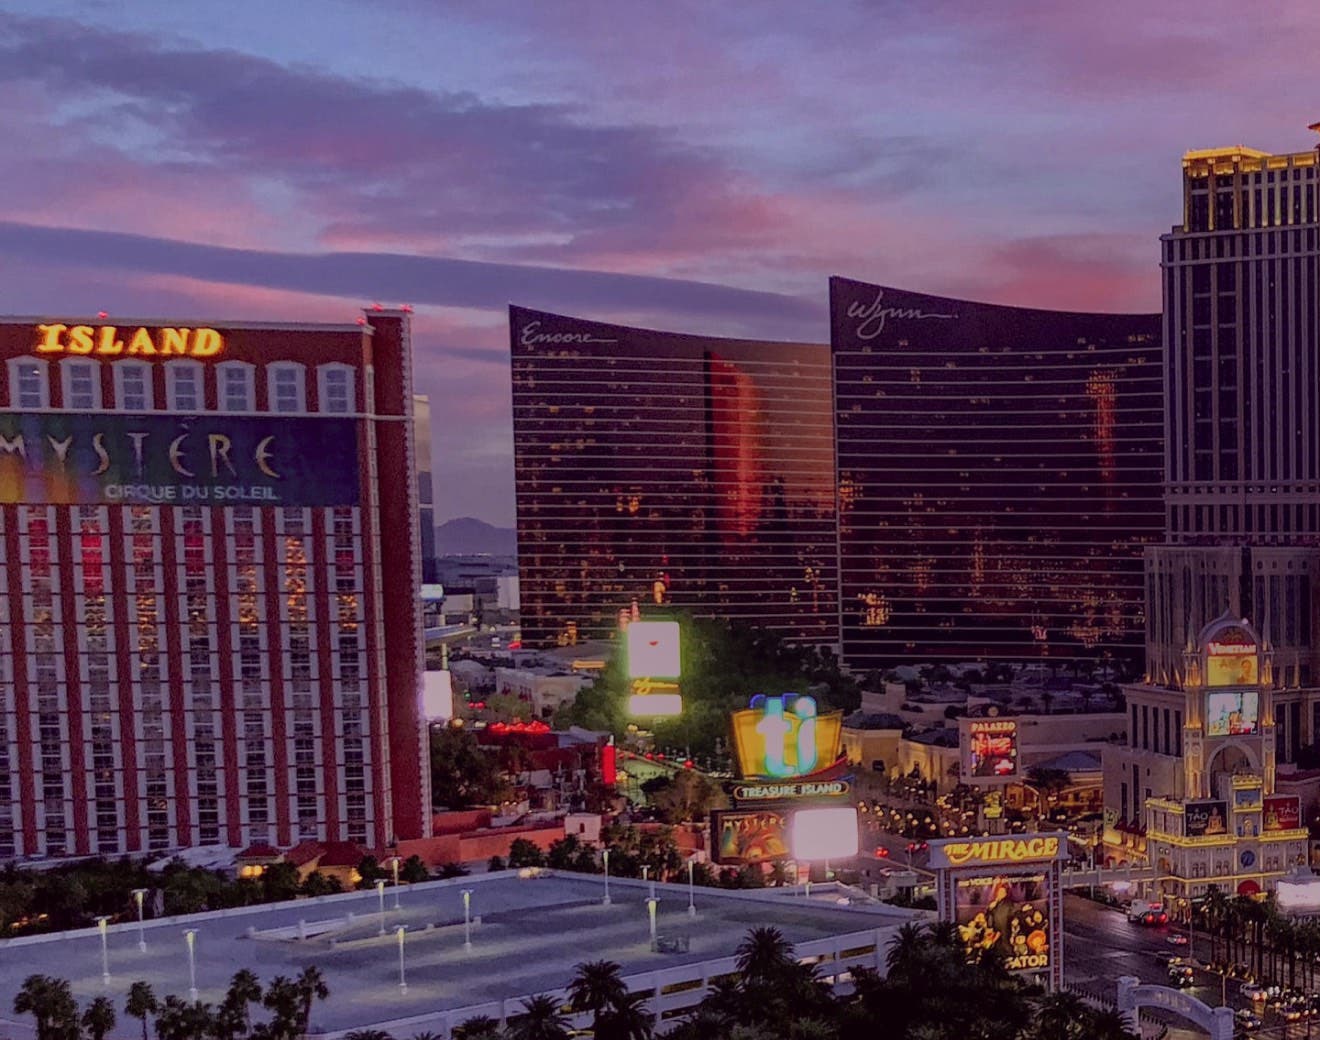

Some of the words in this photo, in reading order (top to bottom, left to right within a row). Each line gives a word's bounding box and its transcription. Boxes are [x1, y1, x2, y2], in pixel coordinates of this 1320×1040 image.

[848, 289, 959, 340] Wynn
[36, 322, 224, 356] ISLAND
[521, 320, 618, 345] Encore
[105, 484, 176, 504] CIRQUE
[182, 486, 209, 500] DU
[214, 485, 281, 500] SOLEIL
[741, 785, 797, 798] TREASURE
[801, 783, 842, 795] ISLAND
[1187, 811, 1209, 821] TAO
[951, 837, 1059, 864] MIRAGE
